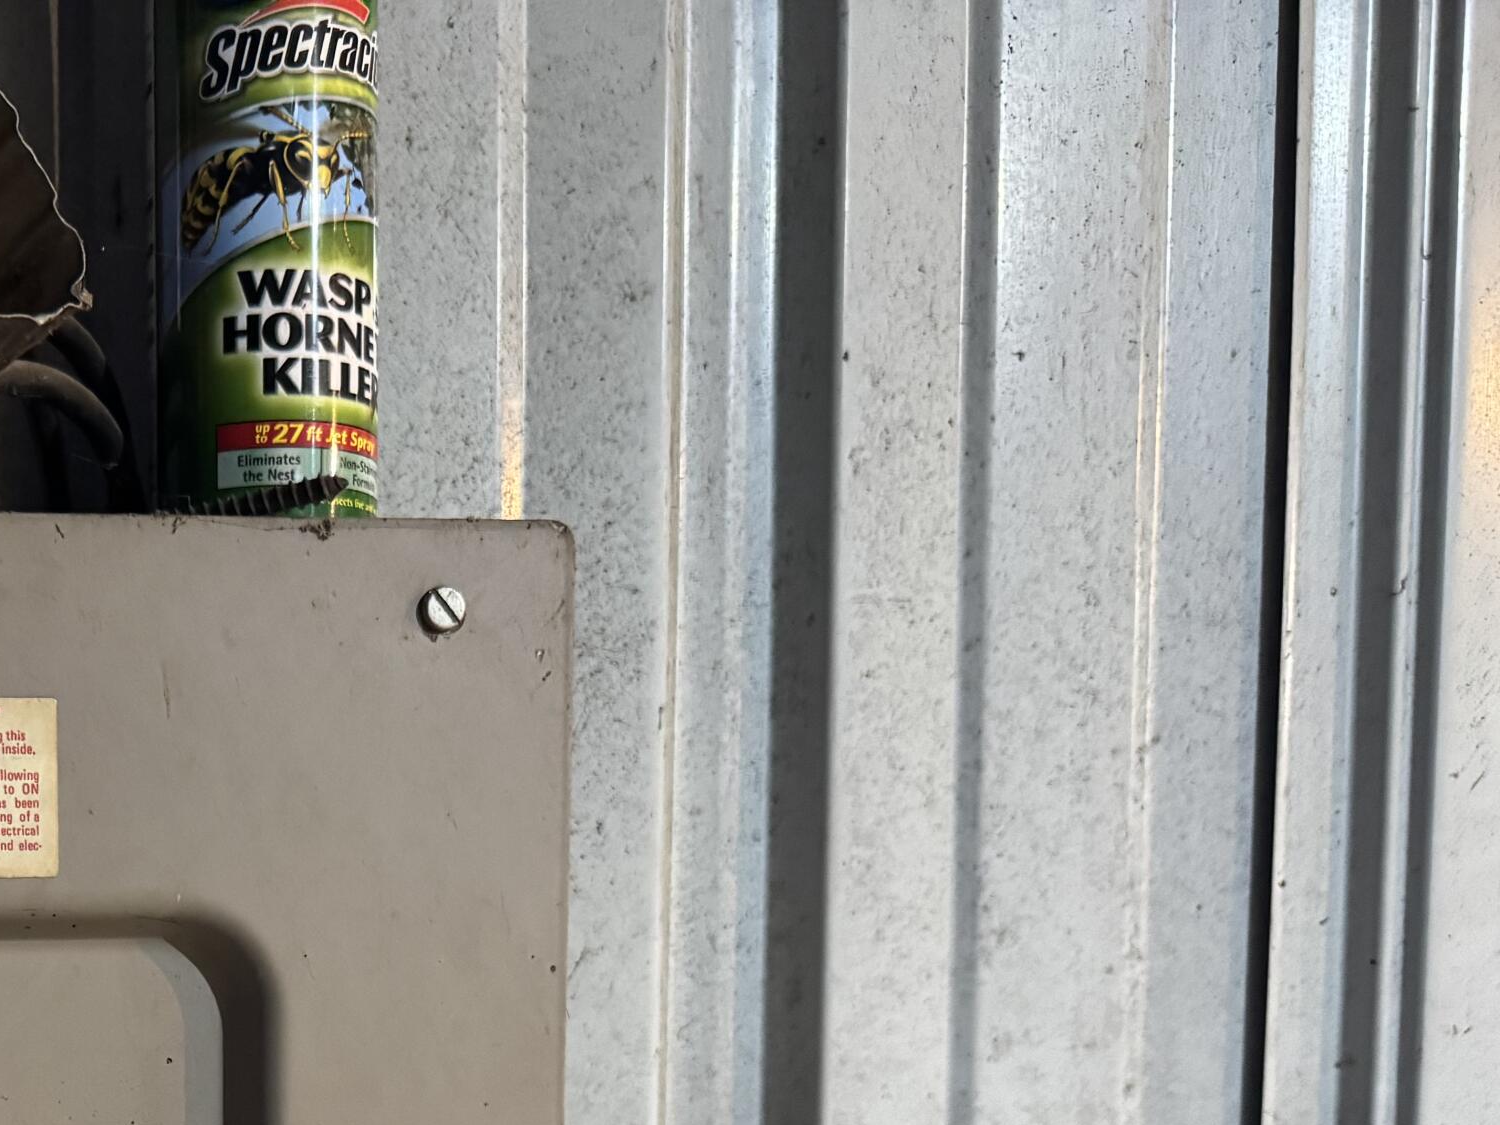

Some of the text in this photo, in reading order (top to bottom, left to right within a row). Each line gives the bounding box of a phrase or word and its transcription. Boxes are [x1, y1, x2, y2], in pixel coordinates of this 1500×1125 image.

[237, 269, 371, 315] WASP
[223, 312, 377, 366] HORNE
[255, 434, 267, 444] to
[255, 423, 375, 456] up 27 ft Jet Spray
[237, 455, 300, 467] Eliminates
[243, 469, 295, 482] the Nest
[5, 730, 26, 744] this
[2, 742, 36, 755] inside.
[3, 784, 15, 796] to
[22, 782, 39, 796] ON
[14, 797, 40, 809] been
[19, 810, 31, 823] of
[34, 813, 40, 823] a
[18, 839, 42, 852] elec-
